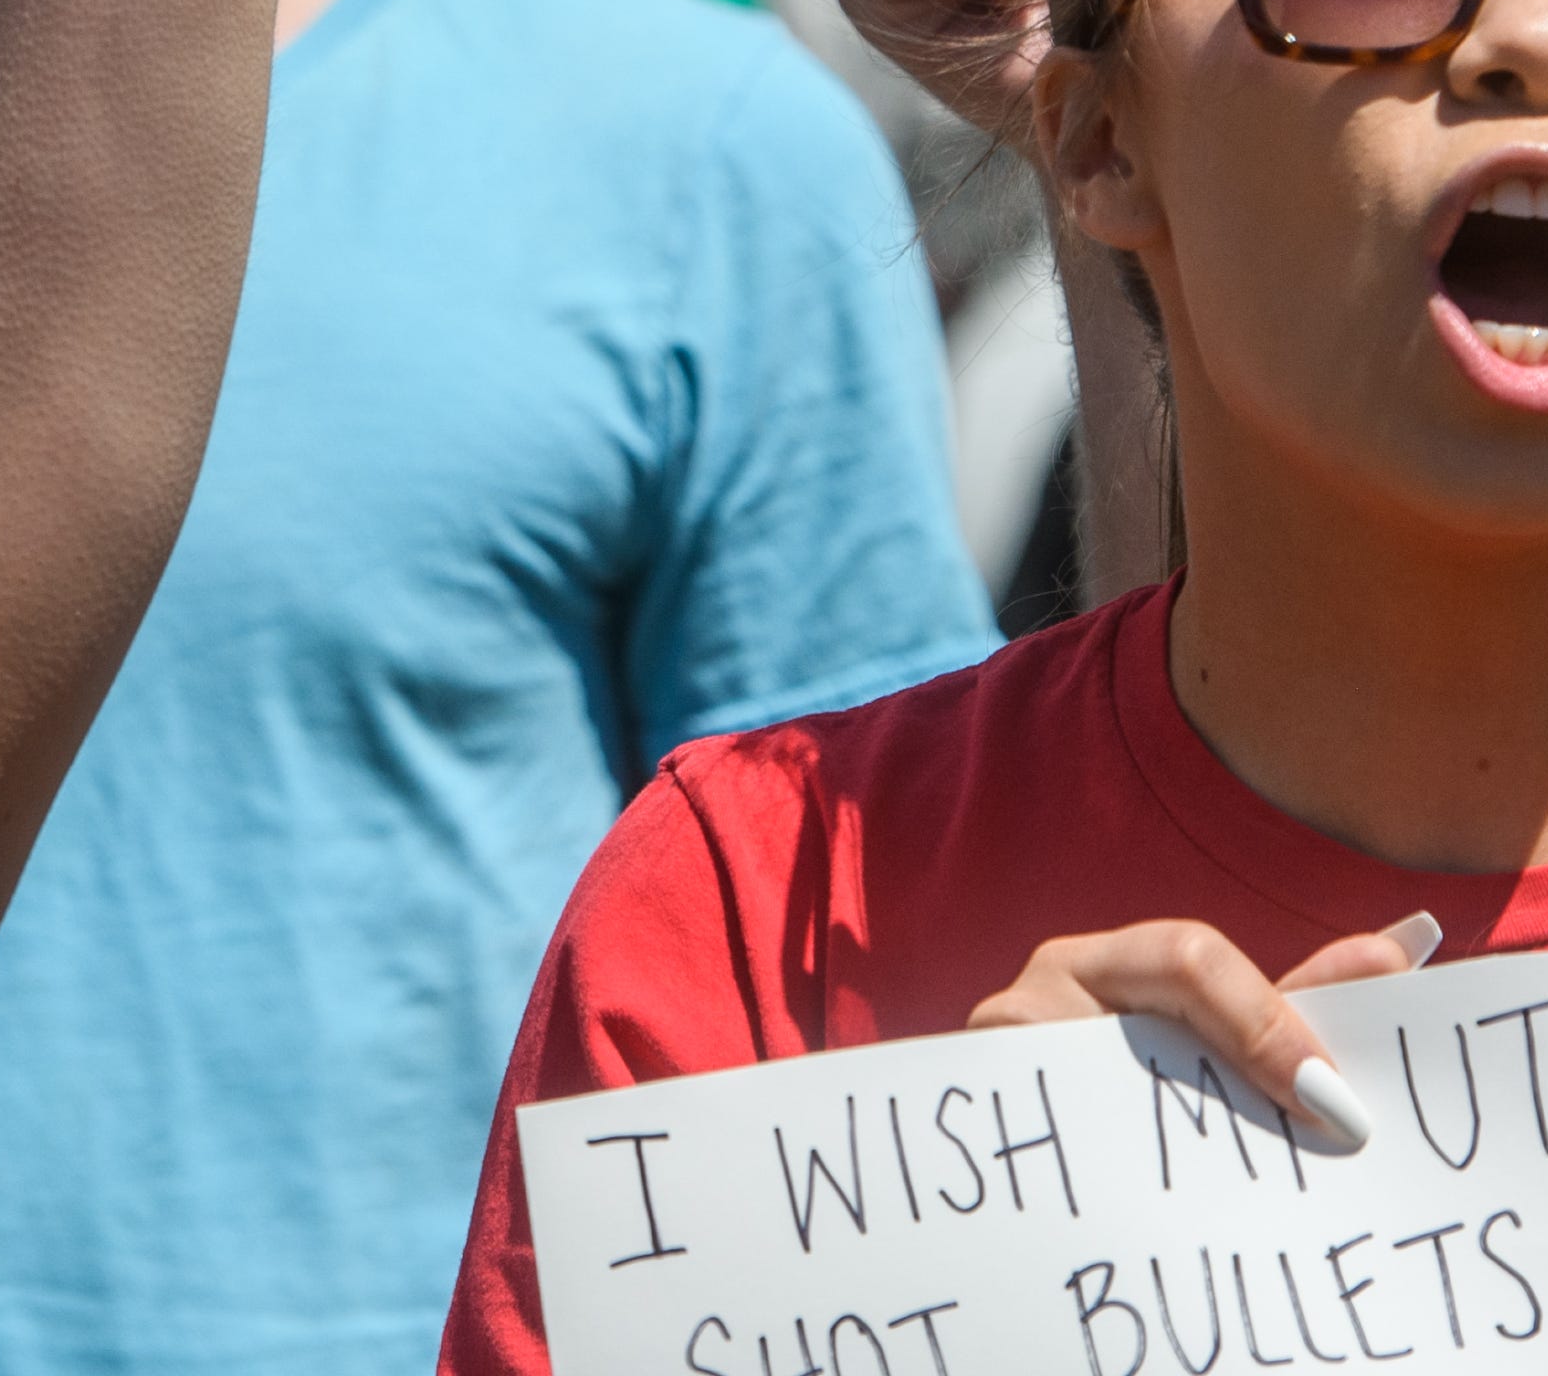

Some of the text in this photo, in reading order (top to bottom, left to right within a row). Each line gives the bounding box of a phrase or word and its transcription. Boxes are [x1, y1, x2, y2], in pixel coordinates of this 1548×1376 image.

[586, 1129, 688, 1269] I
[771, 1067, 1080, 1253] WISH
[1064, 1208, 1544, 1376] BULLETS
